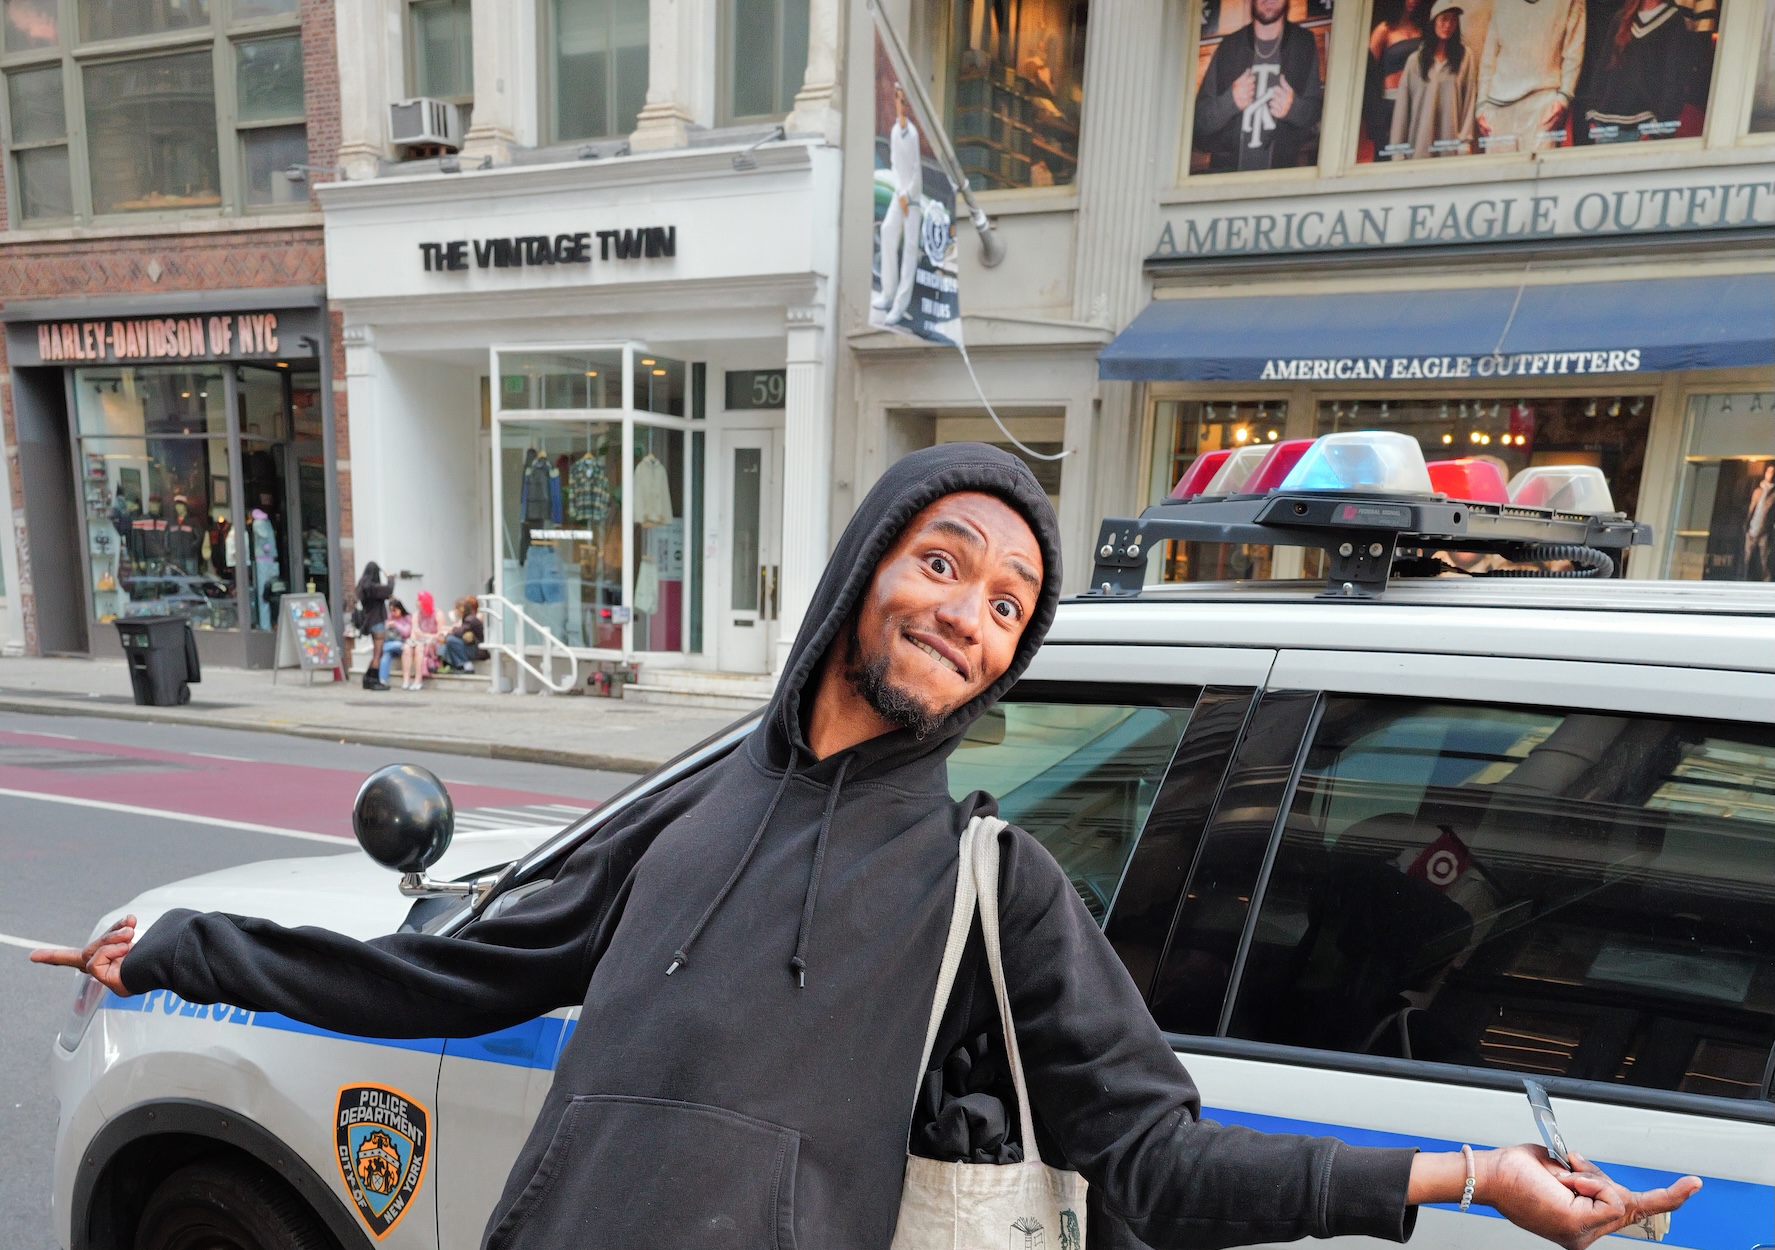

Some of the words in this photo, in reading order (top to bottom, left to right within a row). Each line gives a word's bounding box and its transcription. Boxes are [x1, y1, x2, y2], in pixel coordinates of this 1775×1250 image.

[1153, 207, 1394, 257] AMERICAN
[1404, 194, 1558, 244] EAGLE
[1573, 181, 1775, 233] OUTFIT
[418, 241, 469, 271] THE
[473, 233, 592, 268] VINTAGE
[595, 226, 676, 260] TWIN
[37, 317, 206, 361] HARLEY-DAVIDSON
[208, 316, 233, 355] OF
[238, 312, 279, 354] NYC
[1260, 357, 1387, 381] AMERICAN
[1390, 356, 1472, 379] EAGLE
[1477, 348, 1641, 377] OUTFITTERS
[751, 374, 785, 405] 59
[340, 1106, 423, 1147] DEPARTMENT
[360, 1090, 408, 1119] POLICE
[339, 1145, 355, 1182] CITY
[353, 1189, 368, 1208] OF
[383, 1195, 406, 1225] NEW
[403, 1154, 423, 1193] YORK
